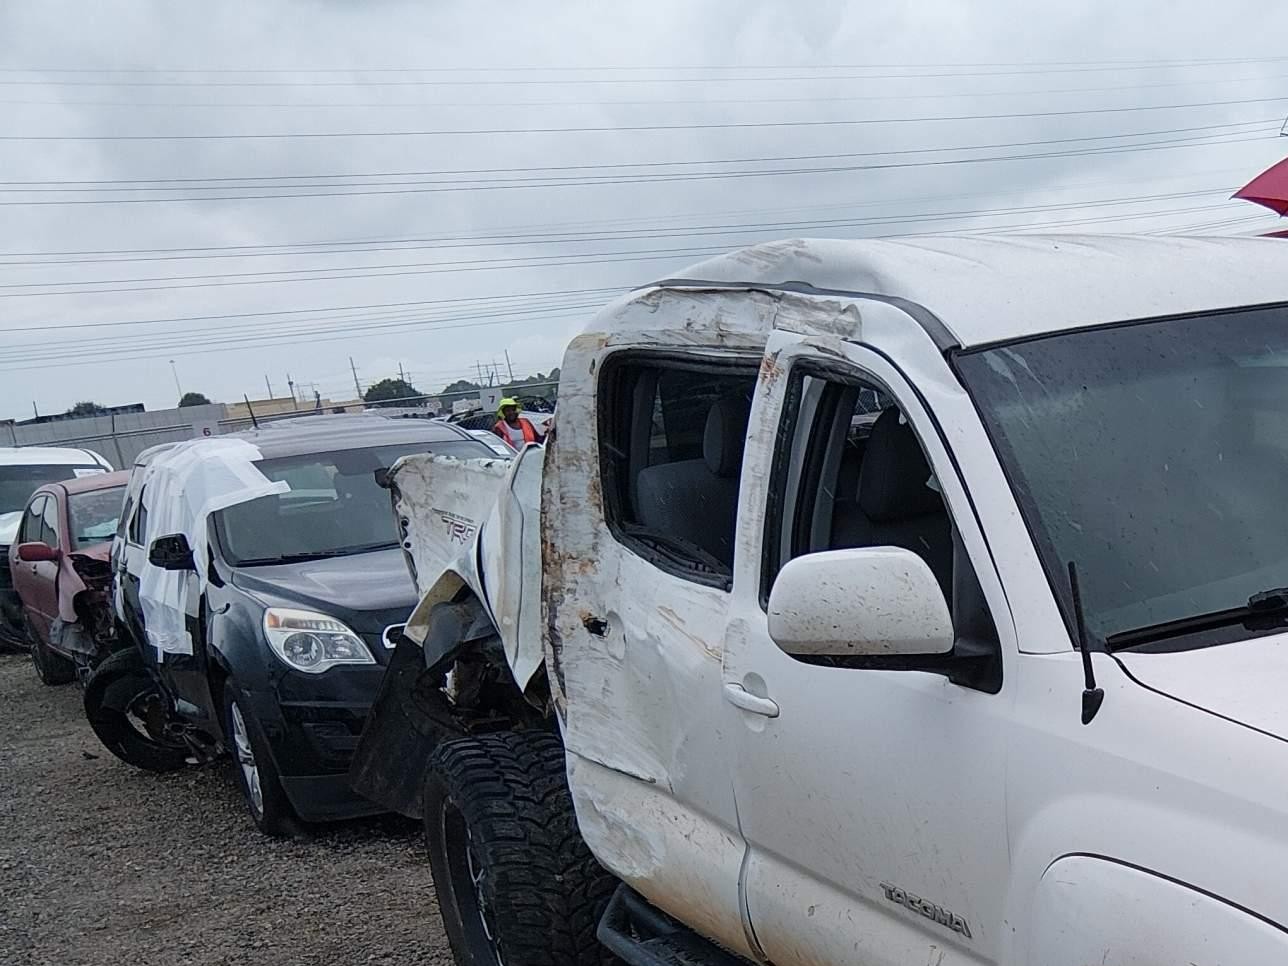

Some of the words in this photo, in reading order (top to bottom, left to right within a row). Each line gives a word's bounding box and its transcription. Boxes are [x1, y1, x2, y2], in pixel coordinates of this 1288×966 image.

[488, 395, 496, 404] 7
[203, 427, 212, 437] 6
[879, 880, 973, 939] TACOMA
